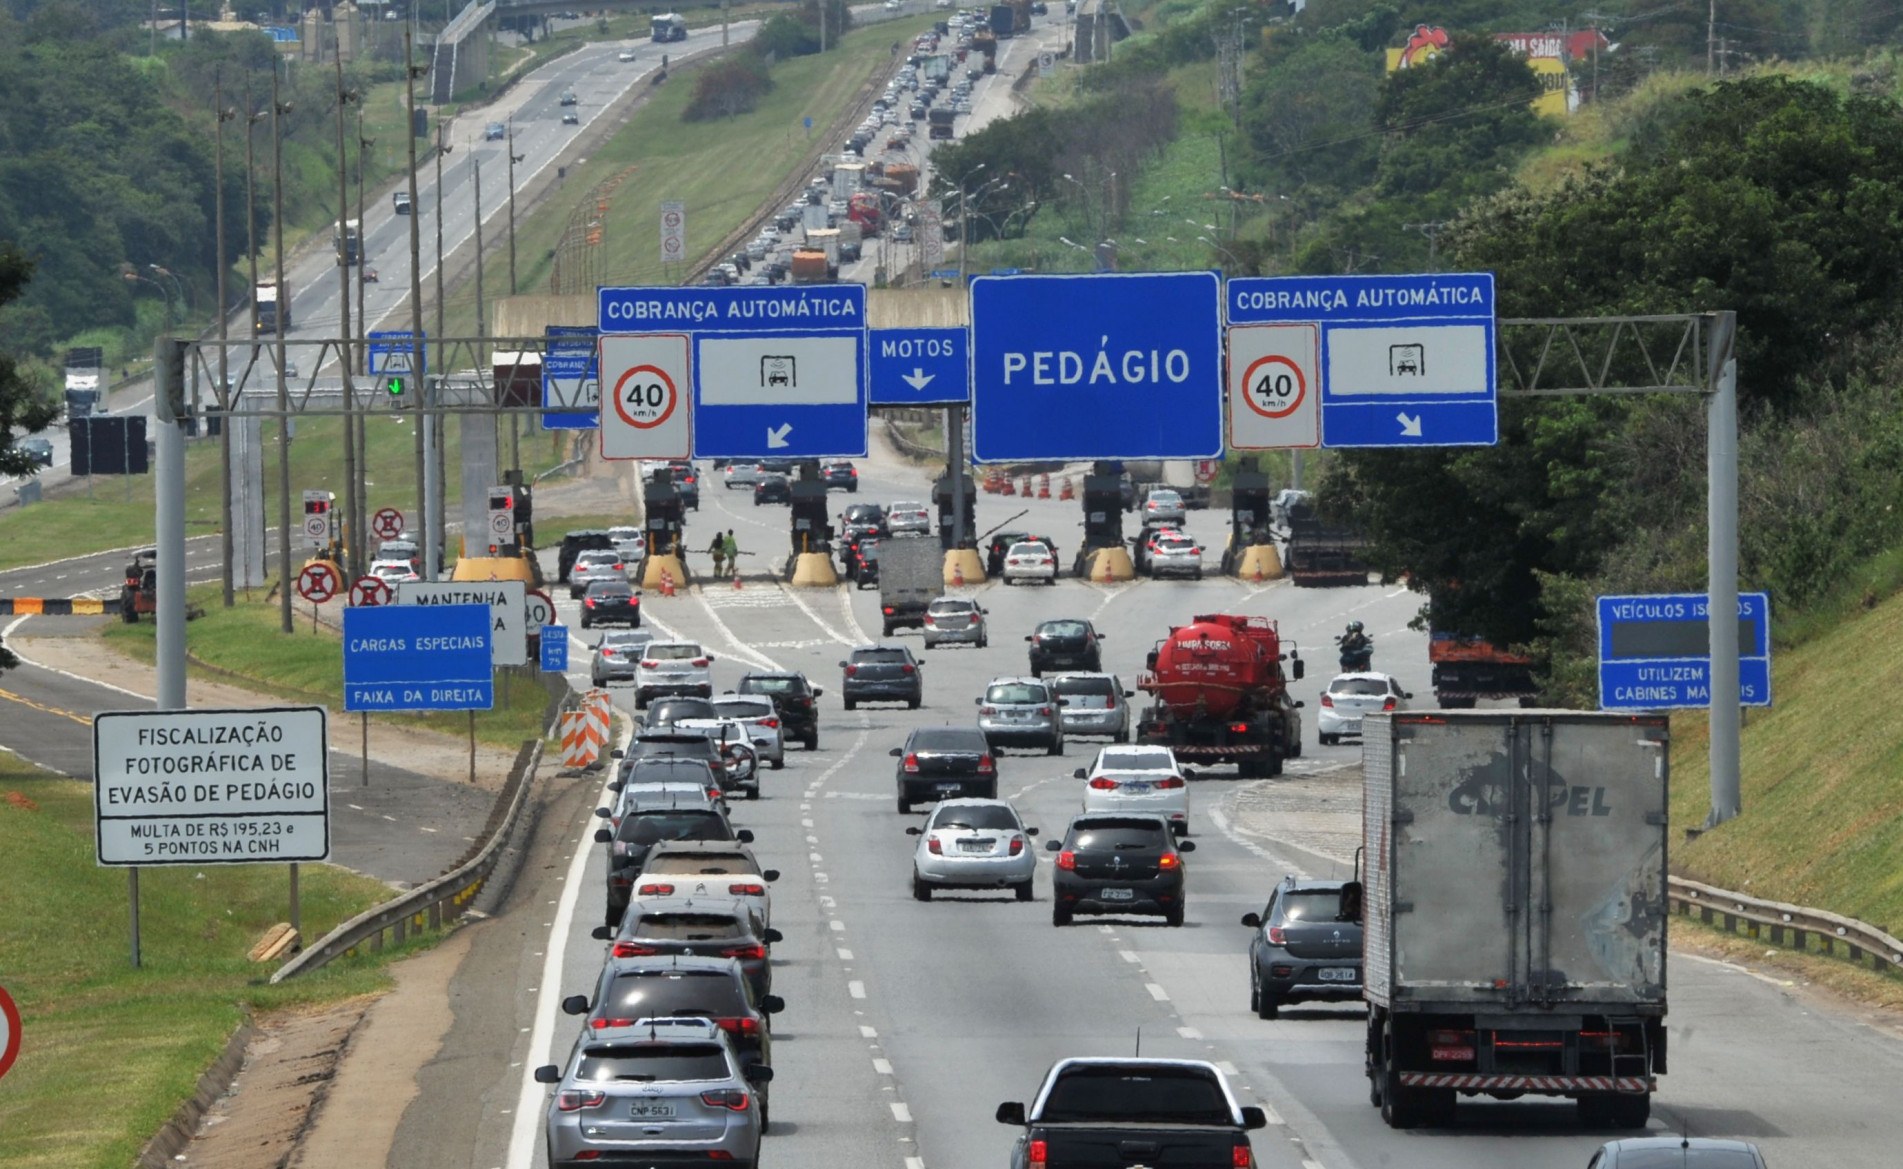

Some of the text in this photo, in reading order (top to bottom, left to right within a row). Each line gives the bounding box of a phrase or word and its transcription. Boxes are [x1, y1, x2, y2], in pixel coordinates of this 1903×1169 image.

[1237, 281, 1484, 312] COBRANÇA AUTOMÁTICA
[608, 292, 856, 323] COBRANÇA AUTOMÁTICA
[882, 339, 954, 358] MOTOS
[1003, 335, 1190, 385] PEDÁGIO
[626, 383, 664, 407] 40
[1256, 374, 1292, 398] 40
[633, 408, 658, 418] km/h
[1262, 399, 1286, 408] km/h
[416, 591, 508, 606] MANTENHA
[1612, 600, 1685, 619] VEÍCULOS
[350, 636, 484, 653] CARGAS ESPECIAIS
[1638, 667, 1704, 681] UTILIZEM
[353, 687, 484, 704] FAIXA DA DIREITA
[1616, 684, 1754, 700] CABINES MAIS
[139, 721, 283, 748] FISCALIZAÇÃO
[126, 751, 296, 774] FOTOGRÁFICA DE
[109, 778, 315, 804] EVASÃO DE PEDÁGIO
[131, 823, 180, 838] MULTA
[186, 823, 204, 836] DE
[210, 822, 228, 838] R$
[286, 825, 294, 834] e
[144, 840, 280, 855] 5 PONTOS NA CNH
